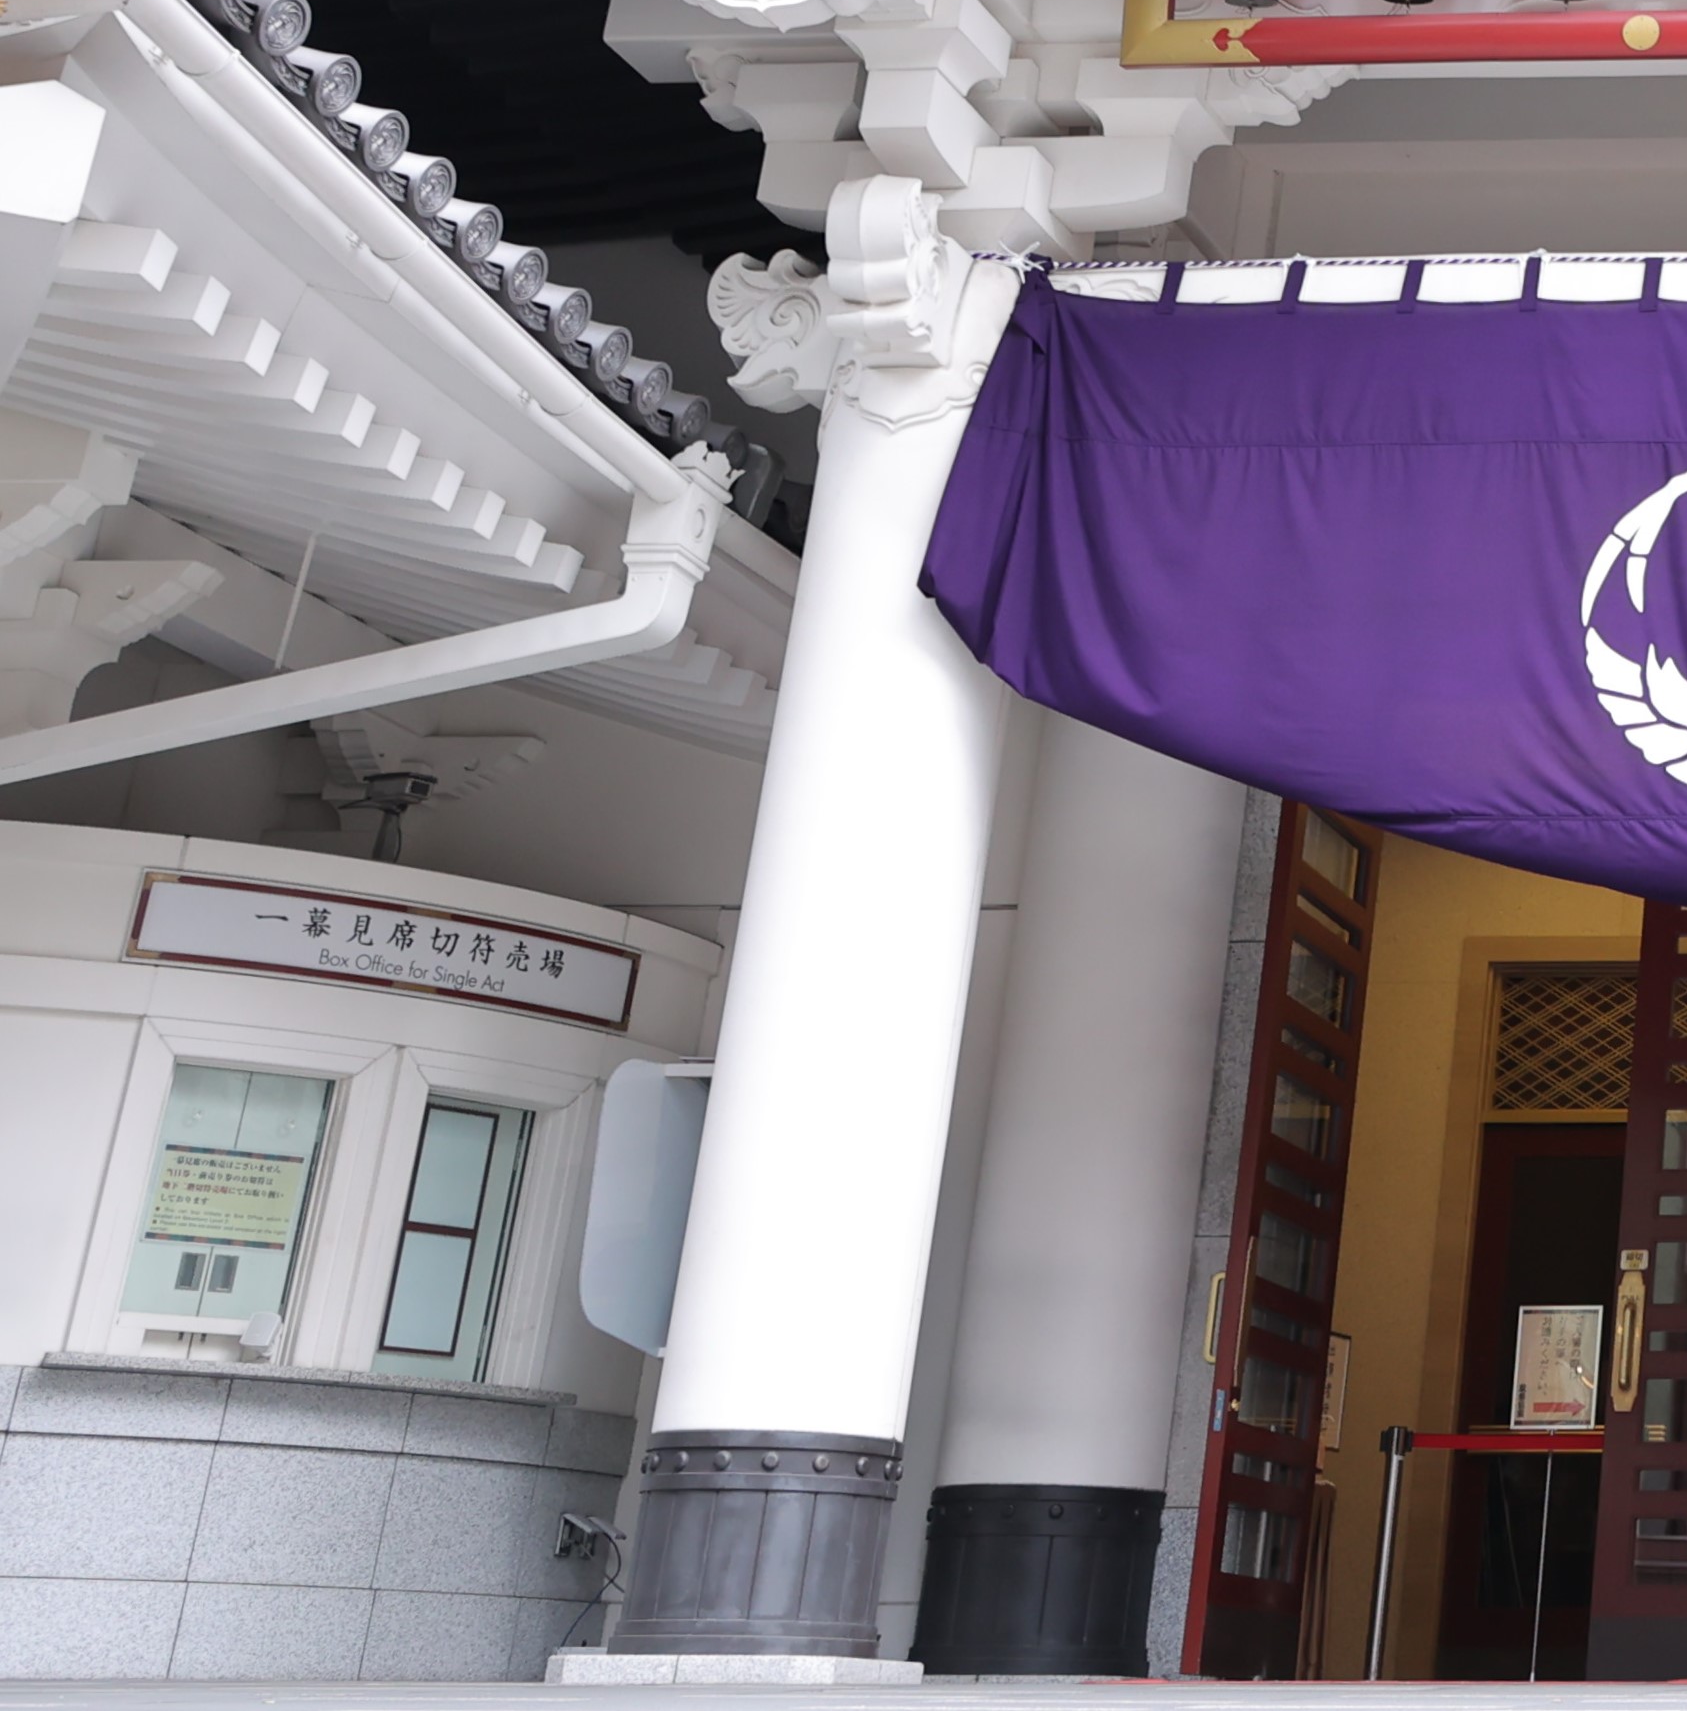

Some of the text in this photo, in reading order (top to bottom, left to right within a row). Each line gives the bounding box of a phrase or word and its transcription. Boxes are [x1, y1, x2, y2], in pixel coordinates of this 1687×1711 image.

[255, 907, 566, 980] 一幕見席切符売場
[318, 949, 505, 993] Box Office for Single Act
